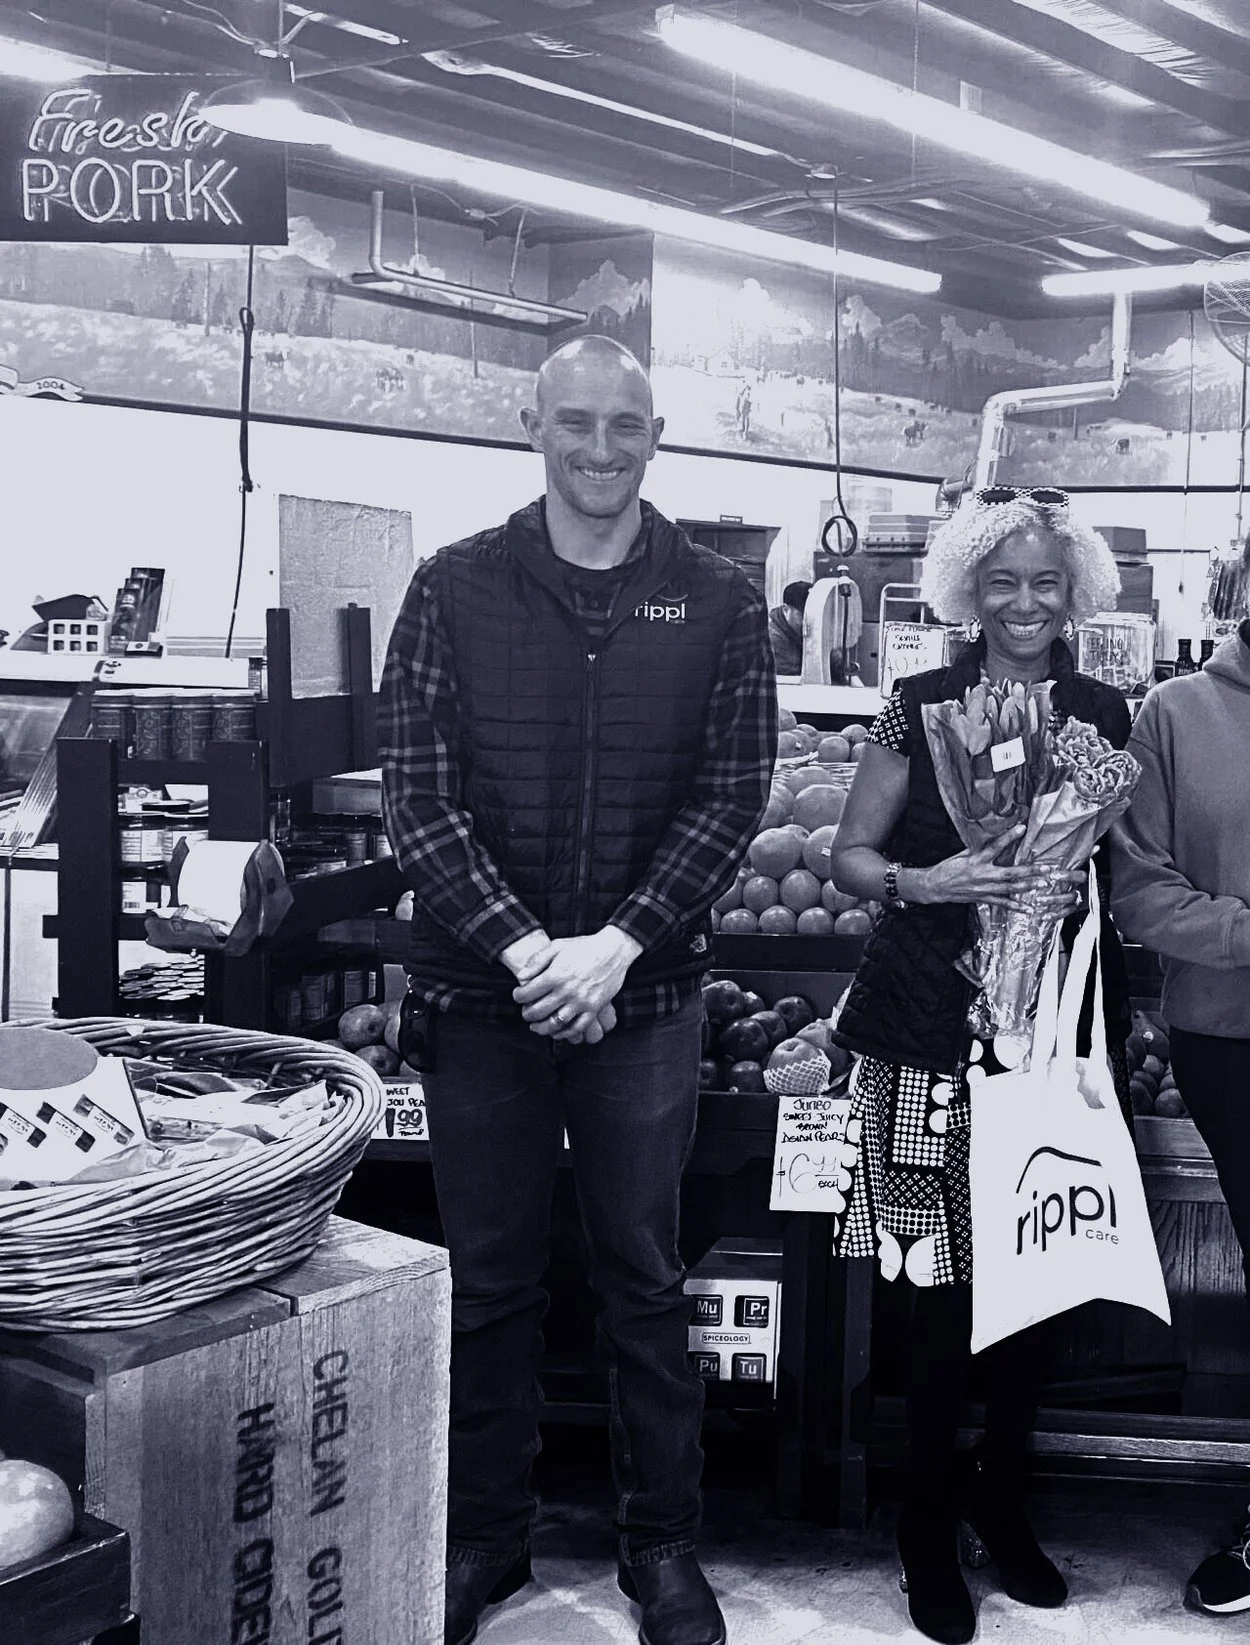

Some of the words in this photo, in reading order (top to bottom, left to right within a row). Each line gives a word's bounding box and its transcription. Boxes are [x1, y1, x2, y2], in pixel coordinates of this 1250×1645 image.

[28, 87, 209, 152] Fresh
[22, 157, 232, 225] PORK
[634, 601, 686, 622] rippl
[793, 1098, 832, 1111] JUMBO
[1016, 1184, 1117, 1255] rippl
[1085, 1229, 1119, 1245] care
[697, 1300, 718, 1314] Mu
[750, 1302, 768, 1316] Pr
[703, 1334, 748, 1342] SPICEOLOGY
[700, 1360, 718, 1373] Pu
[740, 1361, 757, 1374] Tu
[311, 1350, 348, 1518] CHELAN
[234, 1402, 275, 1524] HARD
